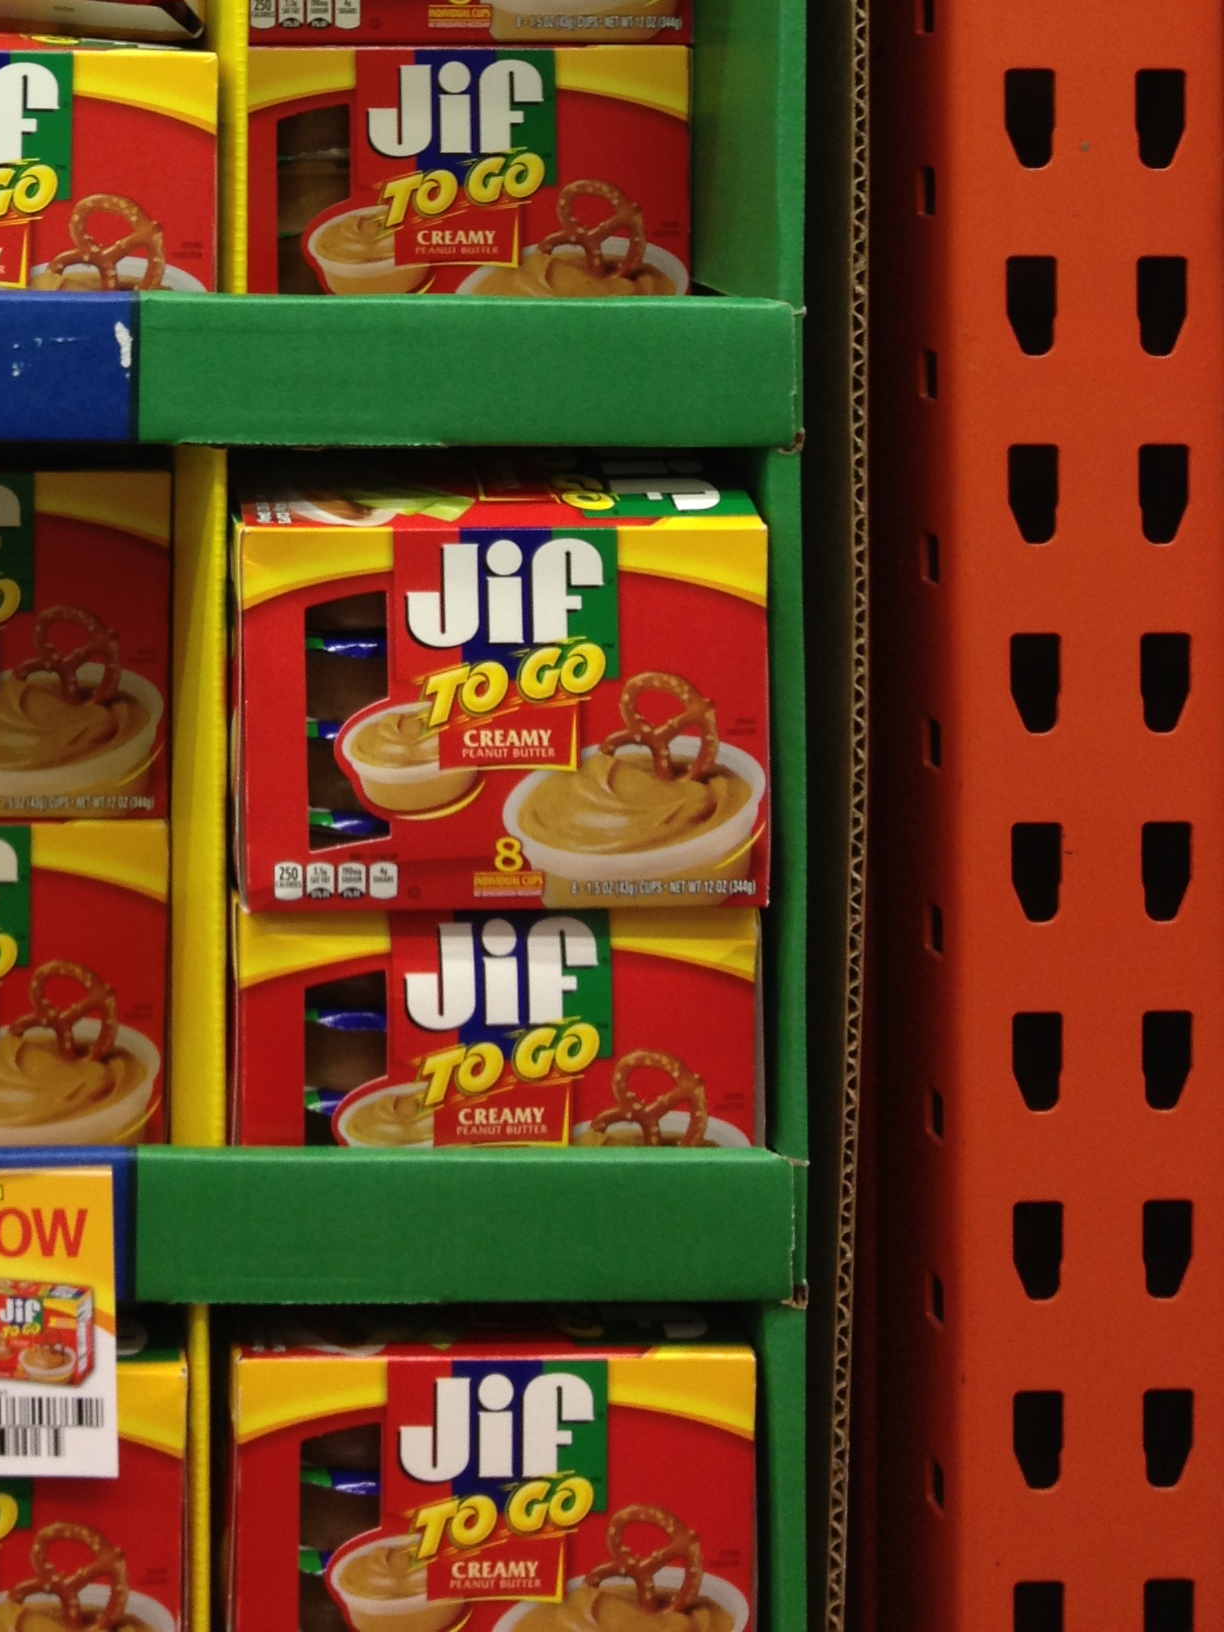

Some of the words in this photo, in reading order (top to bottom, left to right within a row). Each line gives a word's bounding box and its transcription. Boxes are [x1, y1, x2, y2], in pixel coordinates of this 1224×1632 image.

[367, 58, 544, 157] Jif
[381, 169, 458, 229] TO
[465, 151, 546, 205] GO
[416, 229, 496, 246] CREAMY
[406, 537, 604, 648] Jif
[421, 660, 508, 727] TO
[518, 641, 607, 701] GO
[462, 728, 552, 748] CREAMY
[461, 747, 510, 759] PEANUT
[512, 746, 556, 759] BUTTER
[493, 836, 524, 873] 8
[279, 866, 298, 881] 250
[670, 880, 686, 894] NET
[688, 880, 701, 893] WT
[404, 917, 600, 1031] Jif
[418, 1041, 504, 1107] TO
[512, 1022, 601, 1081] GO
[456, 1124, 504, 1136] PEANUT
[505, 1123, 548, 1135] BUTTER
[457, 1106, 545, 1125] CREAMY
[398, 1372, 595, 1483] Jif
[412, 1494, 499, 1559] TO
[505, 1475, 595, 1536] GO
[449, 1578, 497, 1590] PEANUT
[499, 1576, 543, 1590] BUTTER
[451, 1560, 540, 1580] CREAMY
